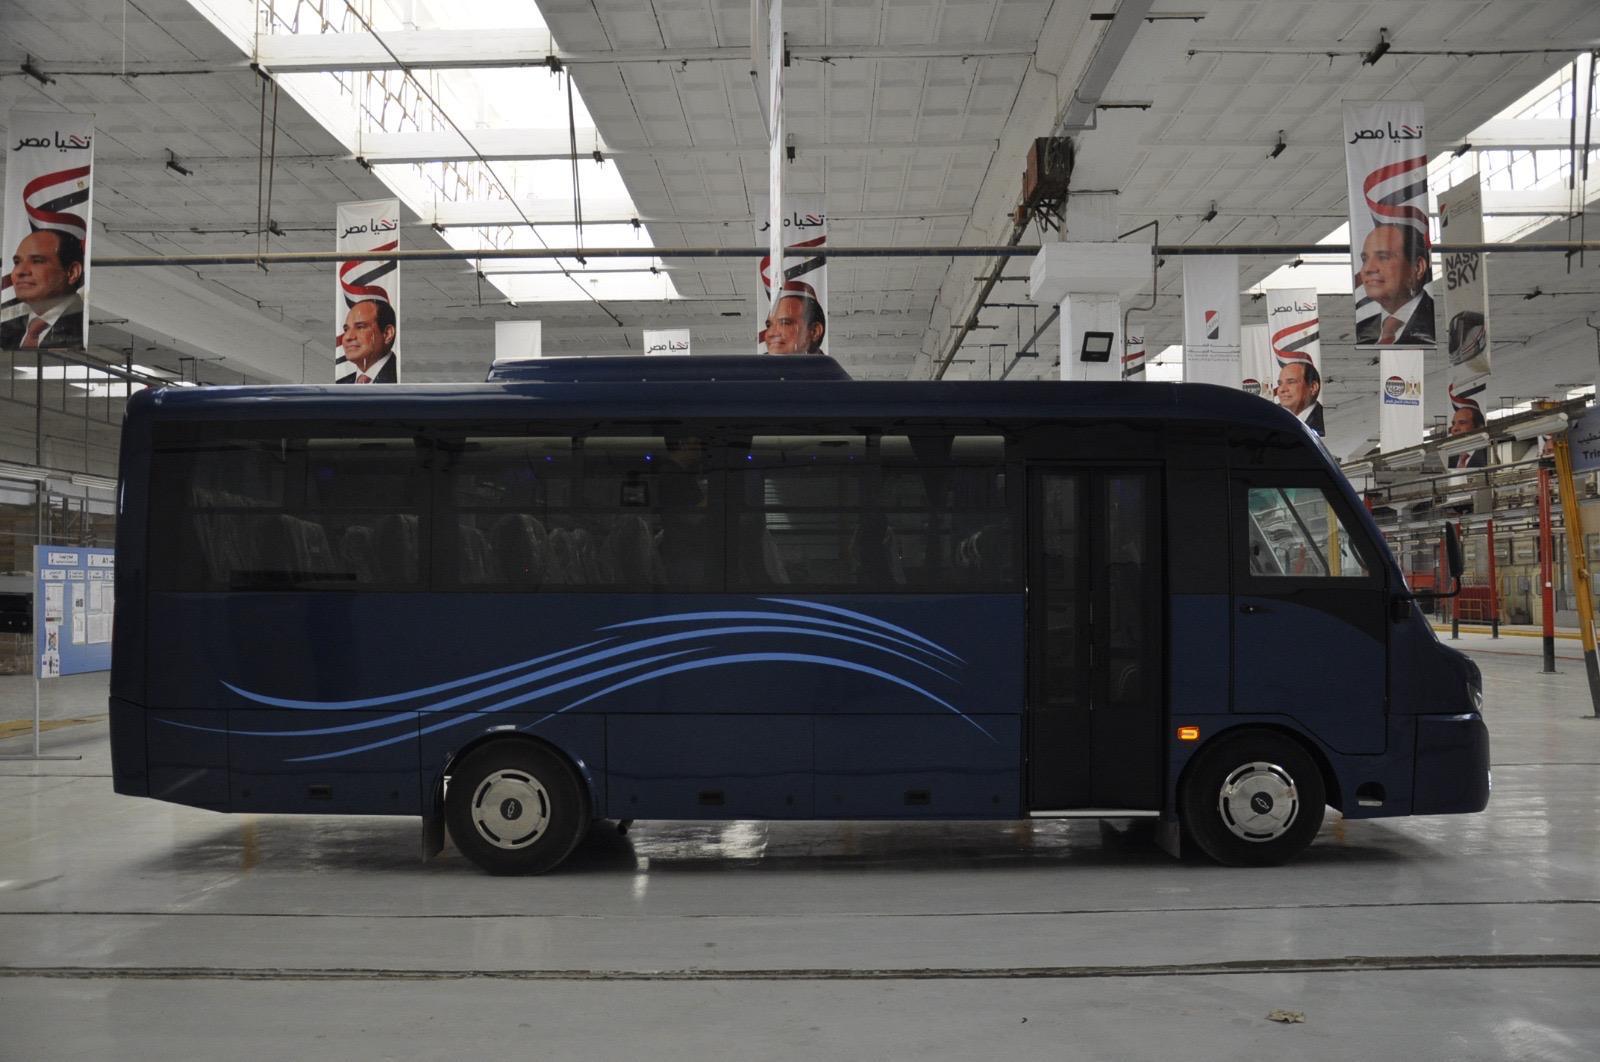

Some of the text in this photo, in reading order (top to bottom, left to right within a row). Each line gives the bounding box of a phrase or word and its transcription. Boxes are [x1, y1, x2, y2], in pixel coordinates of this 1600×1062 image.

[12, 131, 92, 152] تحيا مصر
[1348, 121, 1423, 144] تحيا مصر
[340, 218, 398, 239] تحيا مصر
[760, 211, 825, 231] تحيا مر
[1447, 260, 1480, 291] SKY
[1270, 301, 1317, 316] تحيا مصر
[646, 339, 689, 354] تحيا مصر
